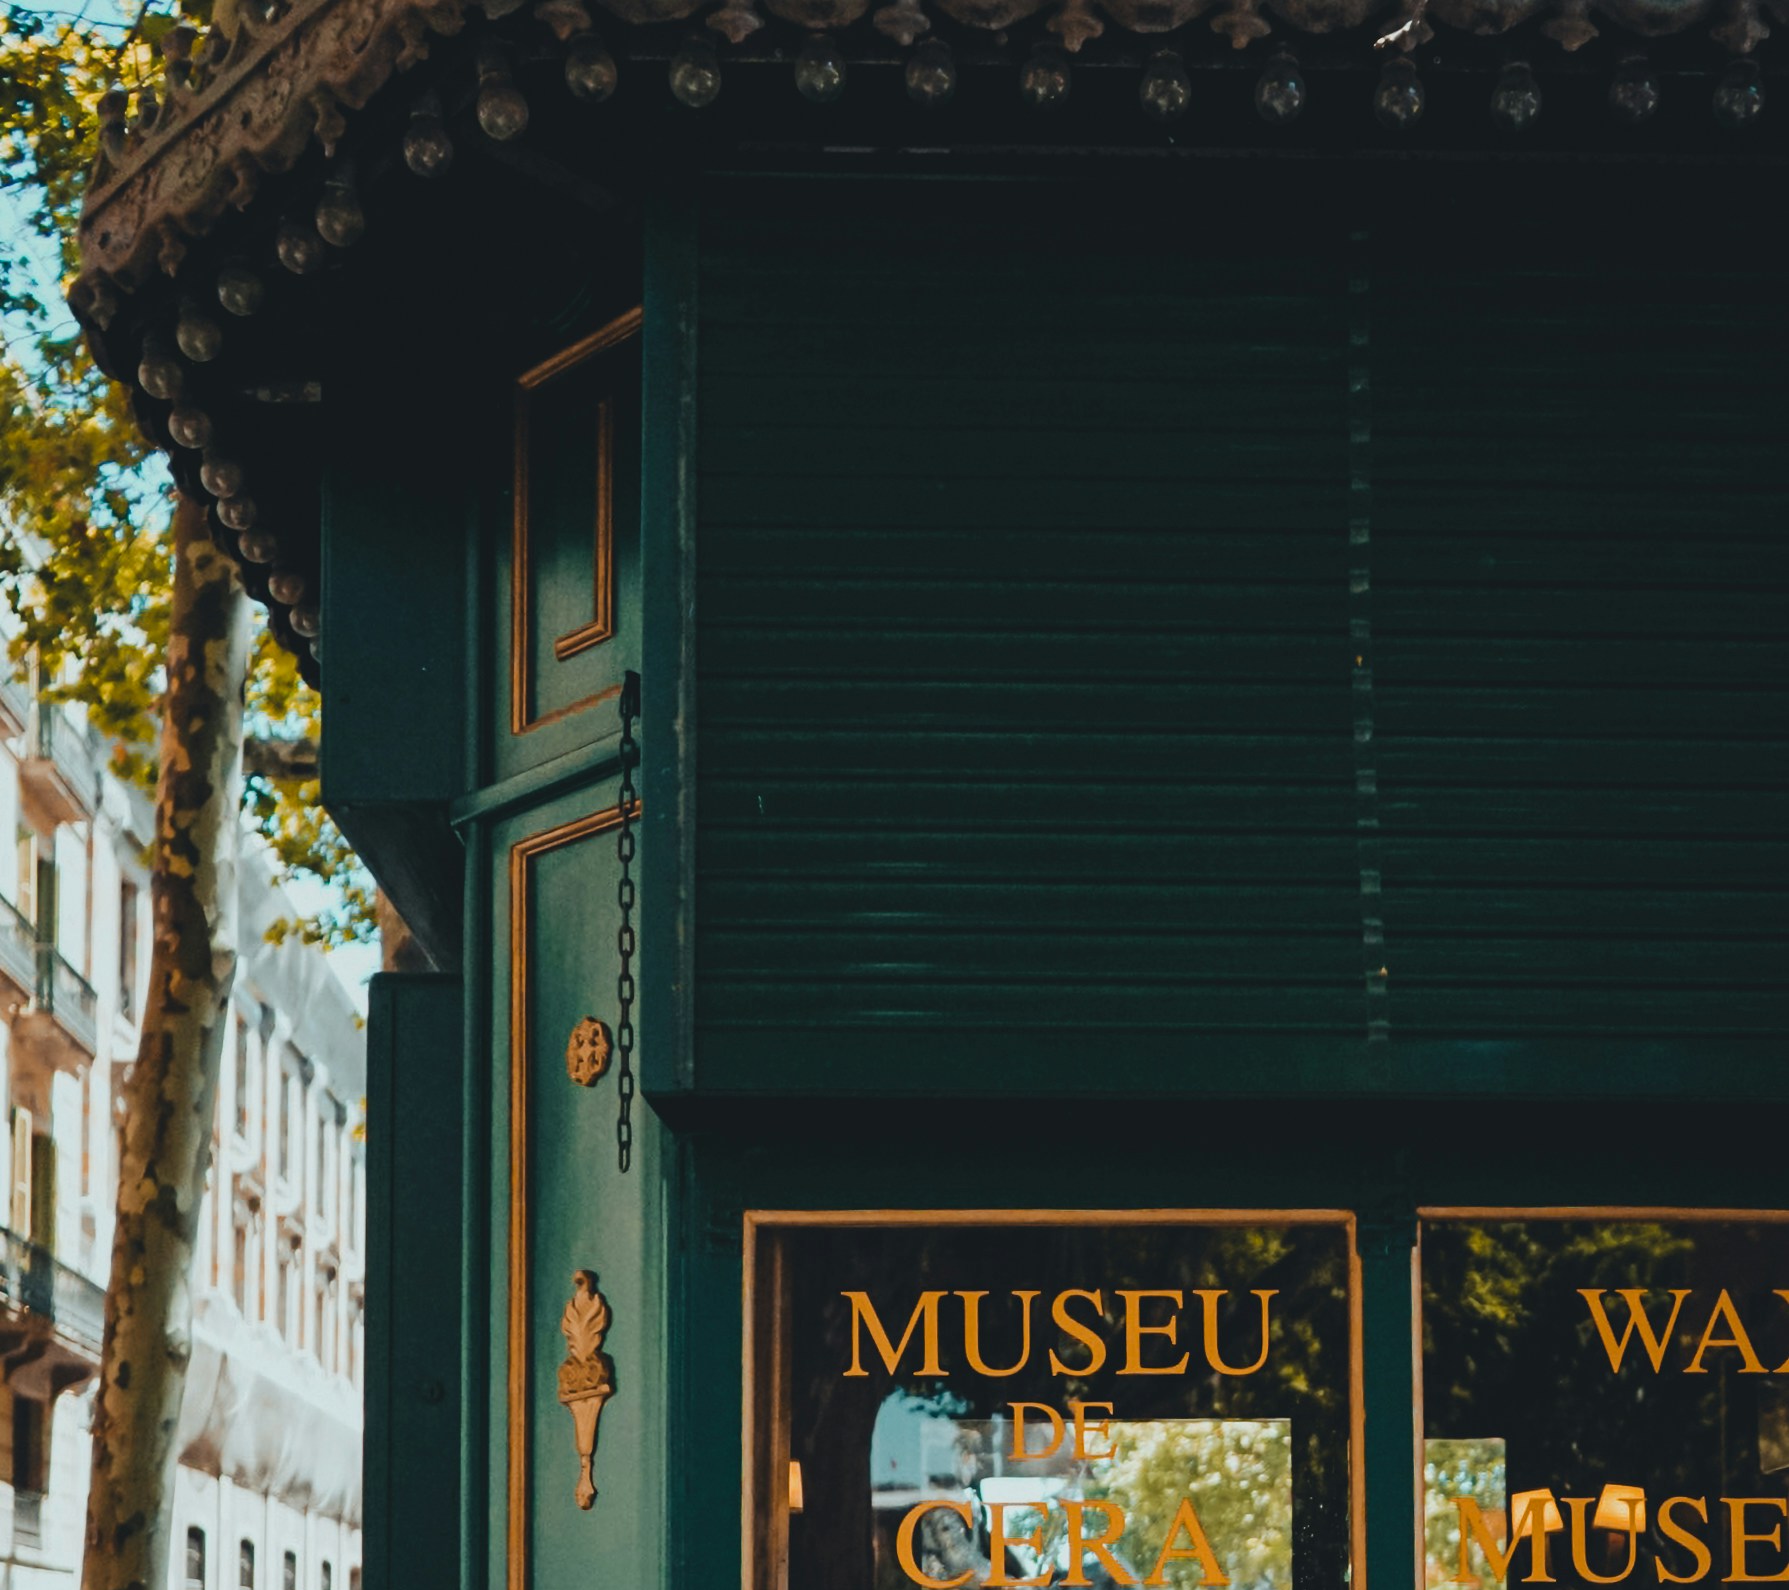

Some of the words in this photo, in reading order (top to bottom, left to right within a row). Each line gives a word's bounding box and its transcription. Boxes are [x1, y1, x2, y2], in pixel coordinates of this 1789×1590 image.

[841, 1289, 1280, 1377] MUSEU
[1576, 1288, 1789, 1374] WA
[1006, 1401, 1118, 1462] DE
[896, 1497, 1230, 1589] CERA
